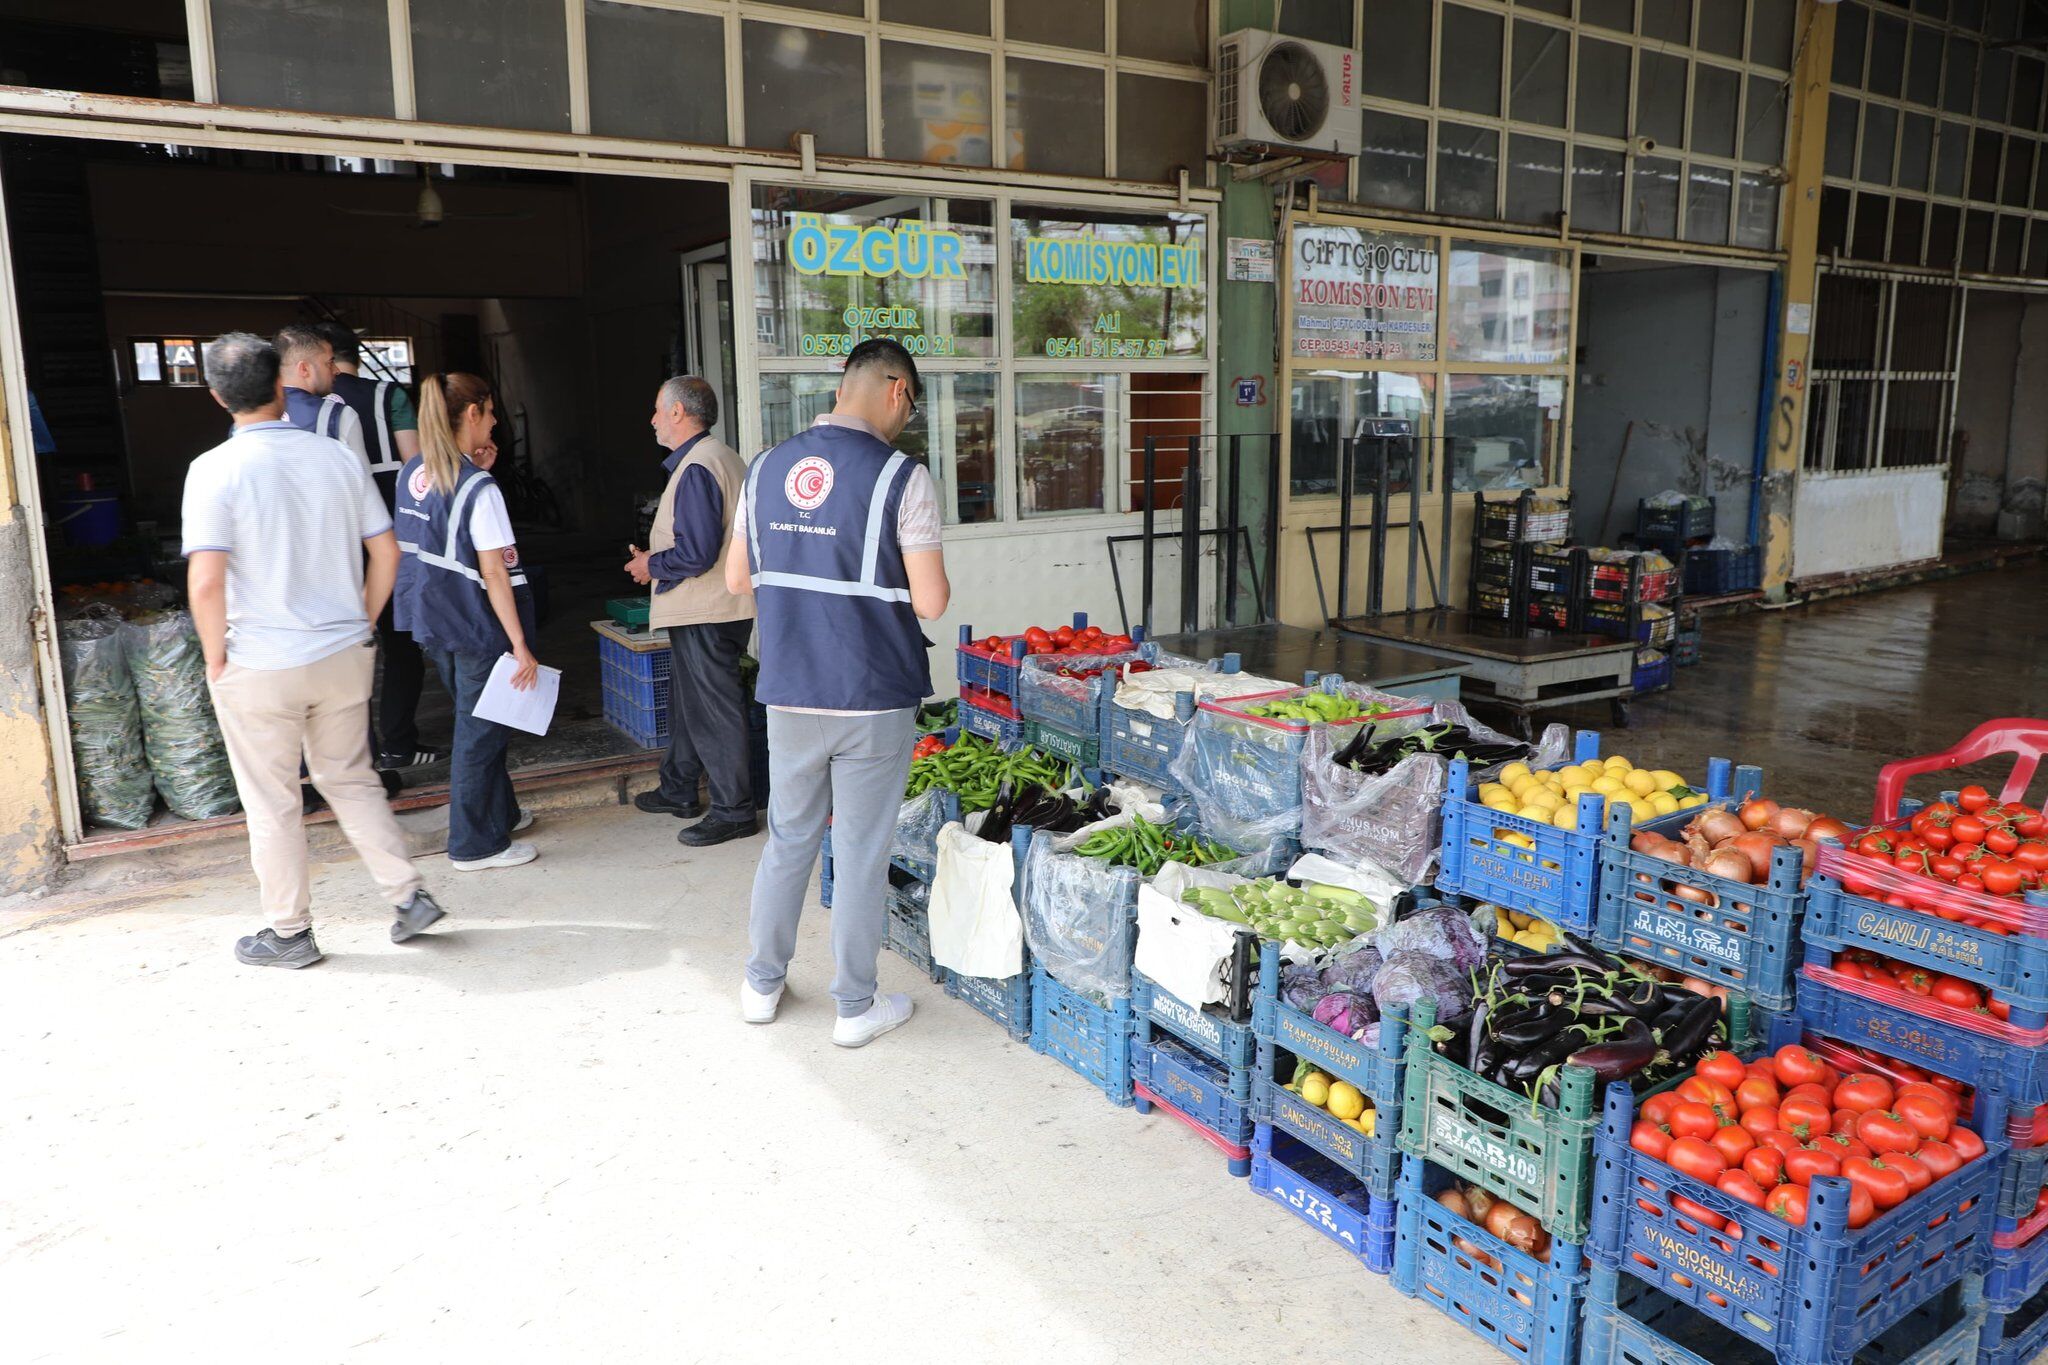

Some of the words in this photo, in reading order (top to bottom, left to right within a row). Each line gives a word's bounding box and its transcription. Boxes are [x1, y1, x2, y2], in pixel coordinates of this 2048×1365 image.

[788, 212, 967, 280] ÖZGÜR
[1026, 235, 1158, 286] KOMİSYON
[1160, 239, 1200, 288] EVİ
[843, 304, 920, 329] ÖZGÜR
[803, 334, 852, 355] 0538
[903, 335, 928, 355] 00
[932, 335, 955, 355] 21
[1046, 337, 1085, 357] 0541
[1091, 337, 1121, 358] 515
[1125, 339, 1144, 358] 57
[1146, 340, 1167, 358] 27
[769, 522, 799, 532] TİCARET
[799, 525, 836, 536] BAKANLIĞI
[1634, 920, 1654, 933] HAL
[1695, 939, 1741, 961] TARSUS
[1437, 1115, 1508, 1163] STAR
[1508, 1153, 1537, 1184] 109
[1273, 1187, 1355, 1244] ADANA
[1295, 1188, 1333, 1220] 172
